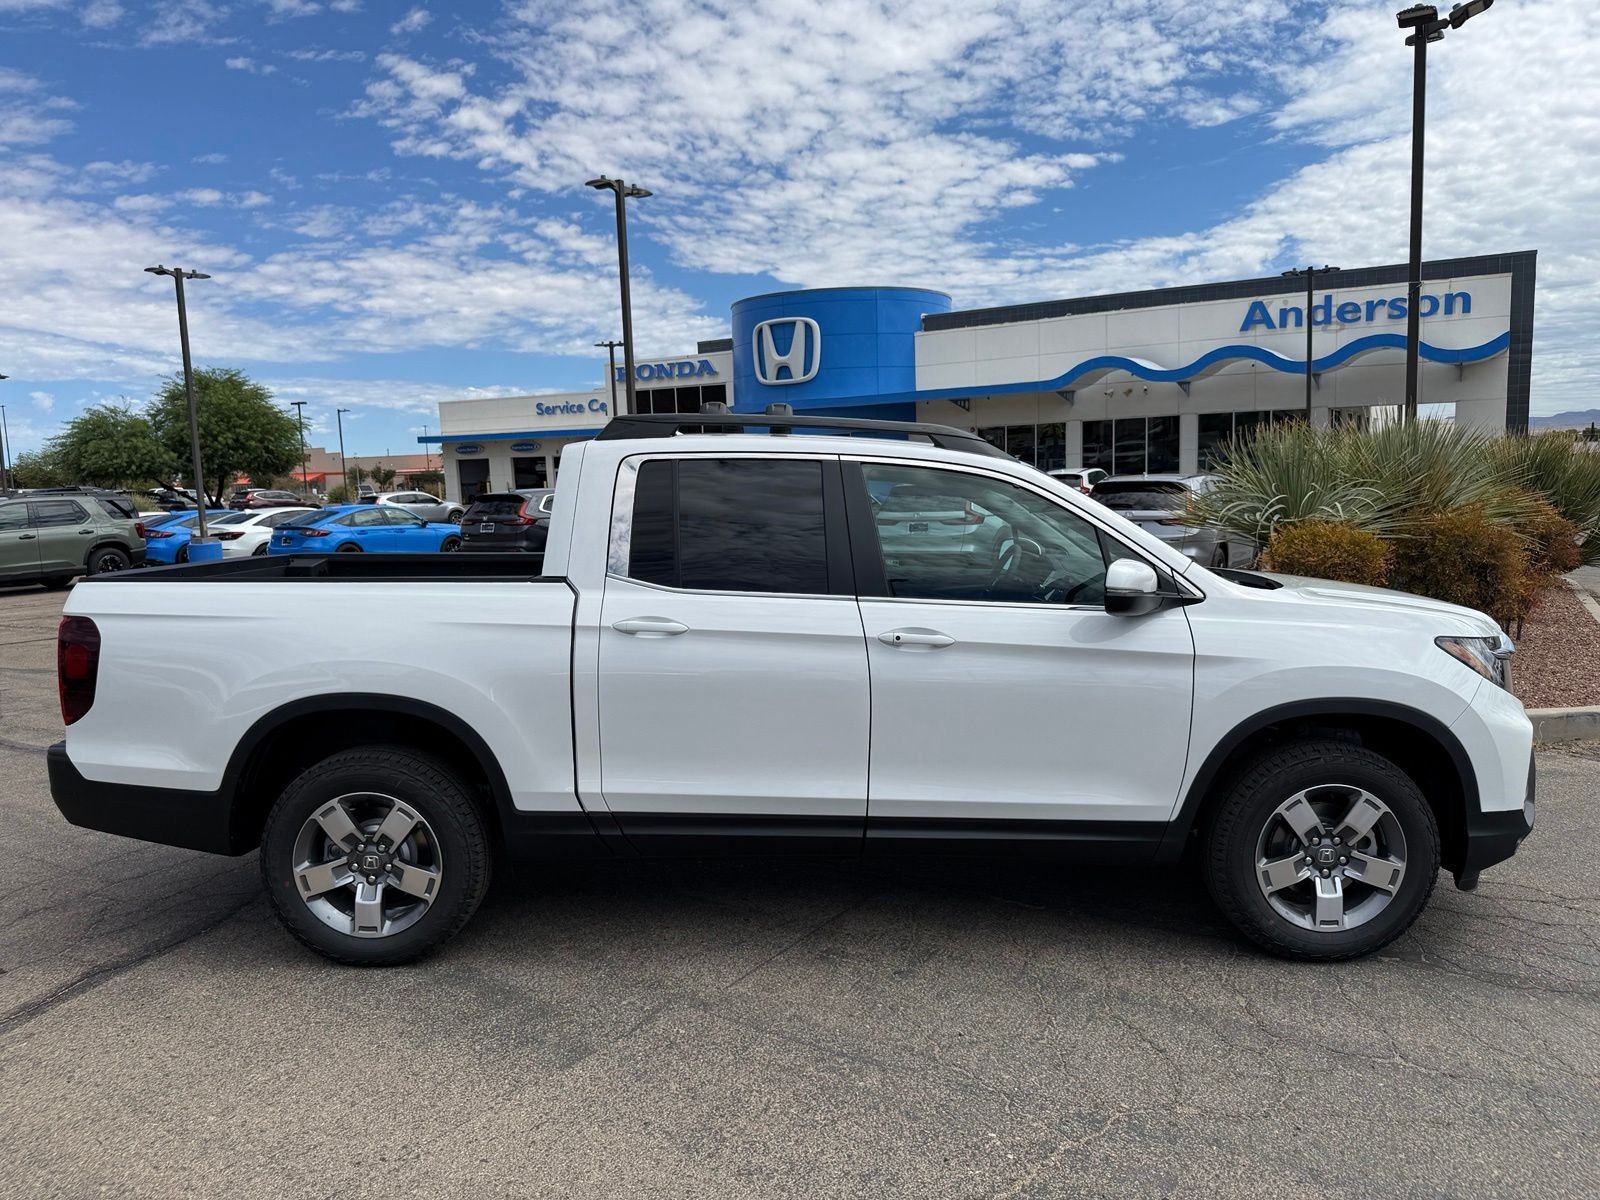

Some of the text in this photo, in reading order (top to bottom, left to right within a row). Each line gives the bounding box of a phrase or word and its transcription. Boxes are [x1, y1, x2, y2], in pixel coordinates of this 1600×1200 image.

[1239, 290, 1472, 332] Anderson
[615, 359, 719, 383] HONDA
[535, 400, 585, 416] Service
